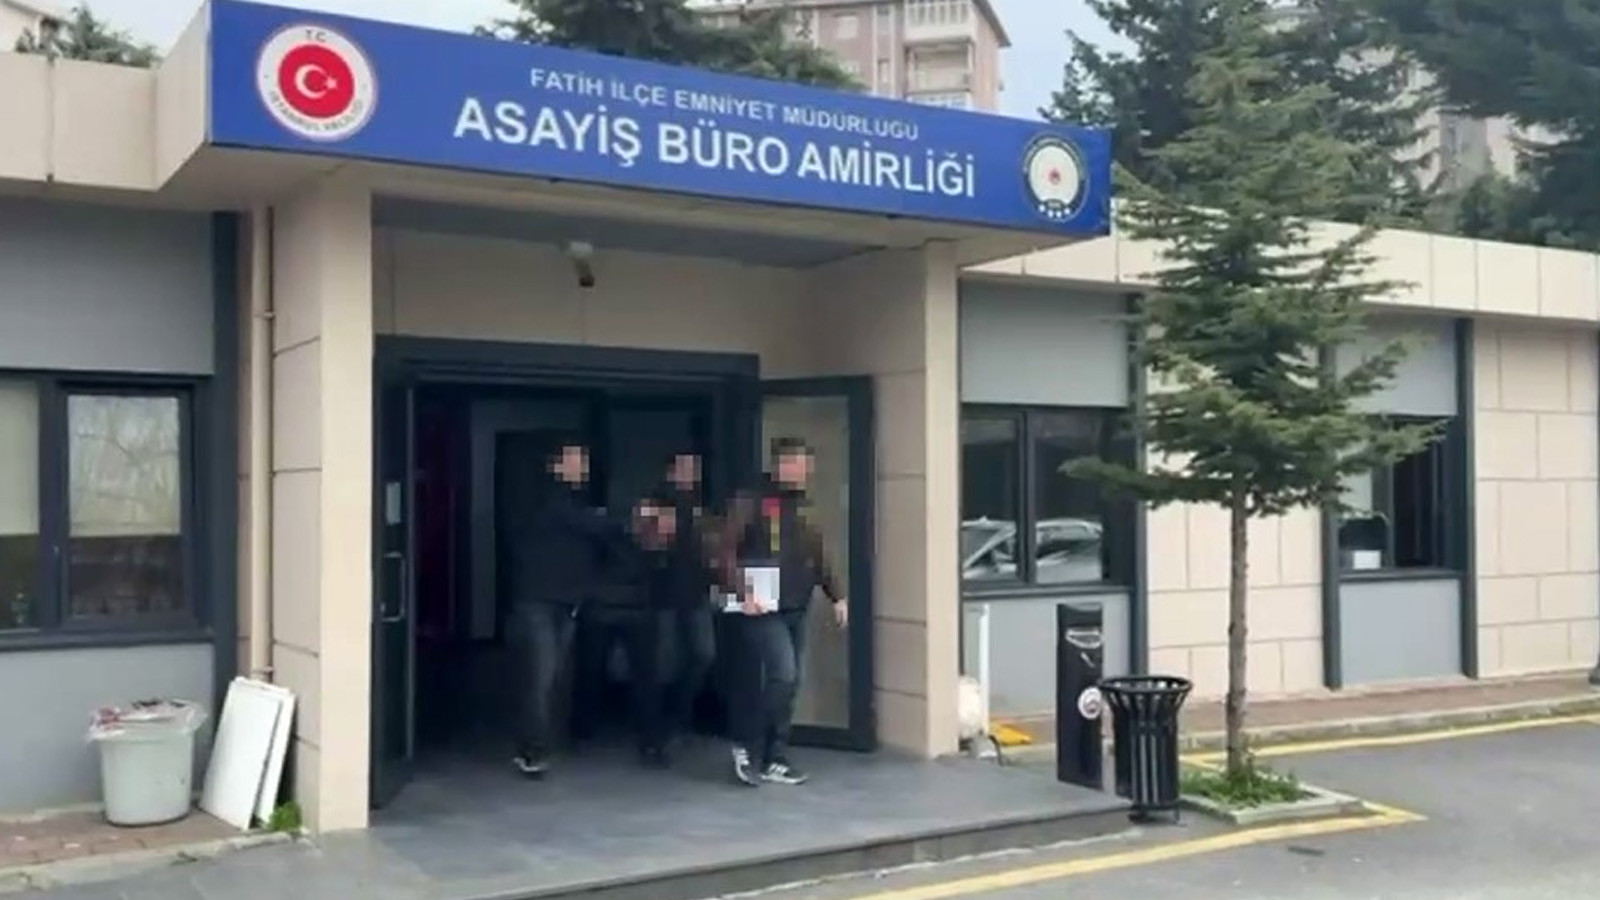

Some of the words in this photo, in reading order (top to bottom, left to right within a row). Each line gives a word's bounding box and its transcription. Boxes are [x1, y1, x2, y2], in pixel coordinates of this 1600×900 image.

[530, 68, 603, 97] FATİH
[674, 89, 776, 121] EMNİYET
[453, 96, 642, 168] ASAYİŞ
[657, 118, 790, 176] BÜRO
[796, 140, 975, 198] AMİRLİĞİ
